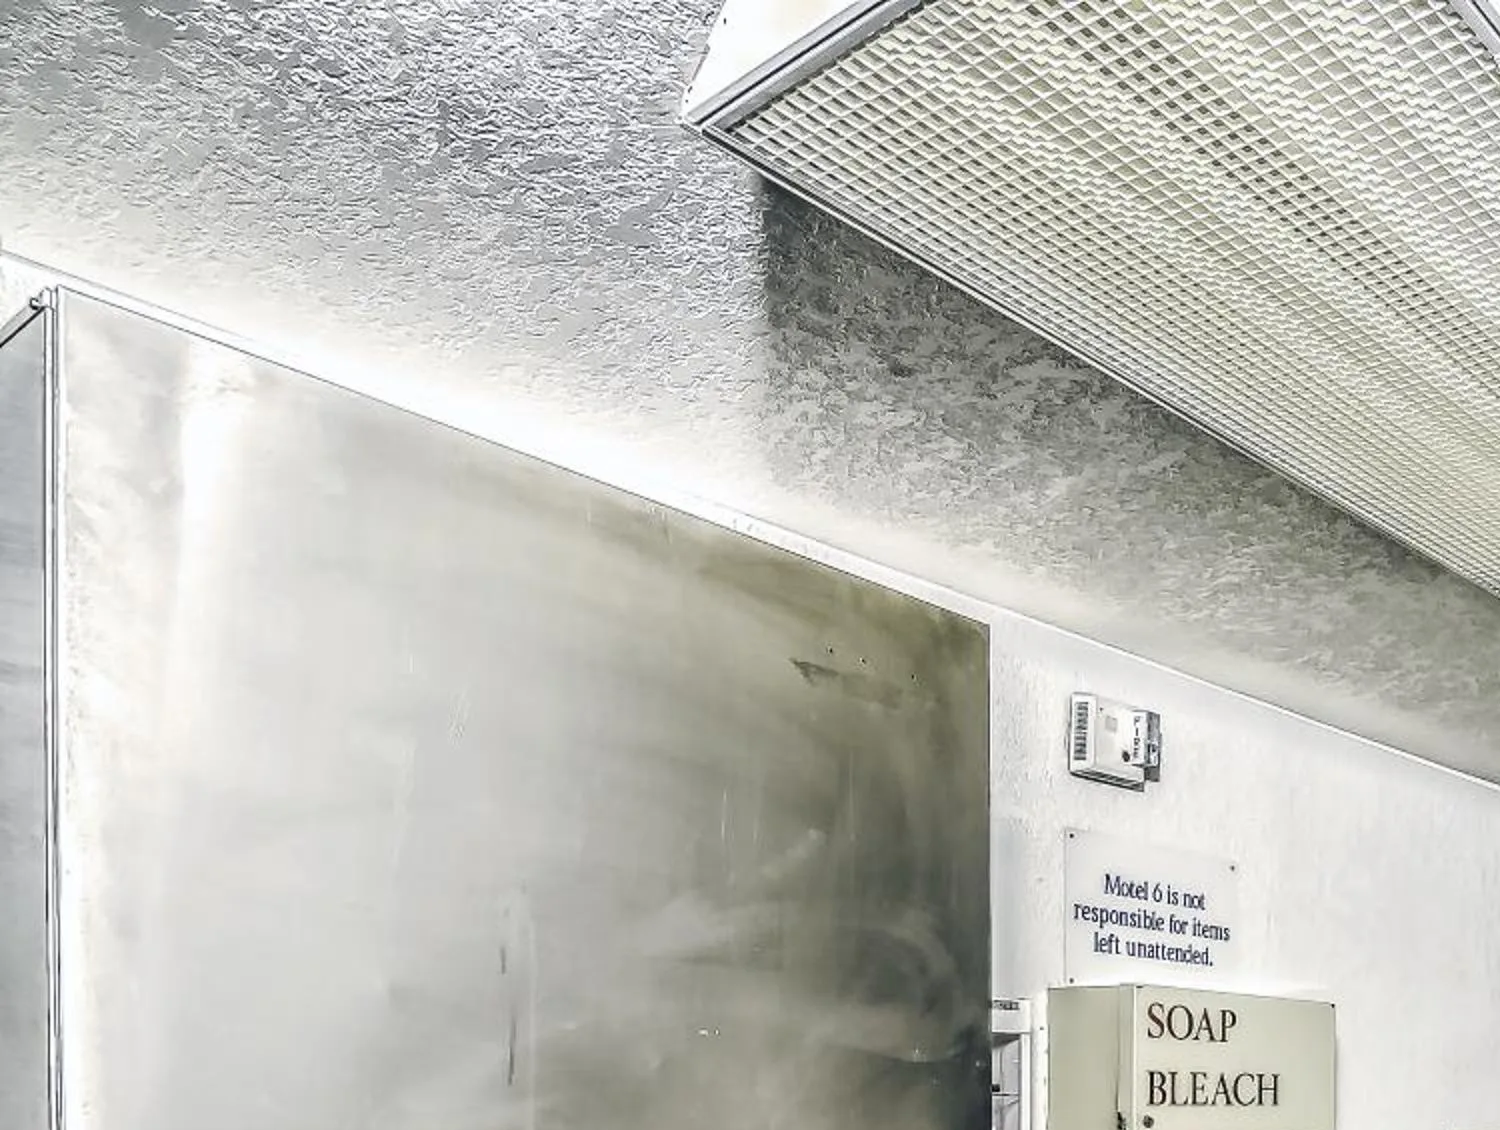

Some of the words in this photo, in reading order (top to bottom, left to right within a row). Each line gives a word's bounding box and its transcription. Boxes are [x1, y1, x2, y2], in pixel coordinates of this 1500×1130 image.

[1104, 873, 1148, 900] Motel
[1152, 883, 1163, 903] 6
[1166, 885, 1179, 906] is
[1183, 892, 1206, 910] not
[1073, 903, 1164, 931] responsible
[1169, 913, 1188, 934] for
[1192, 917, 1231, 941] items
[1093, 932, 1121, 954] left
[1126, 940, 1213, 966] unattended.
[1146, 1002, 1237, 1042] SOAP
[1146, 1069, 1280, 1107] BLEACH
